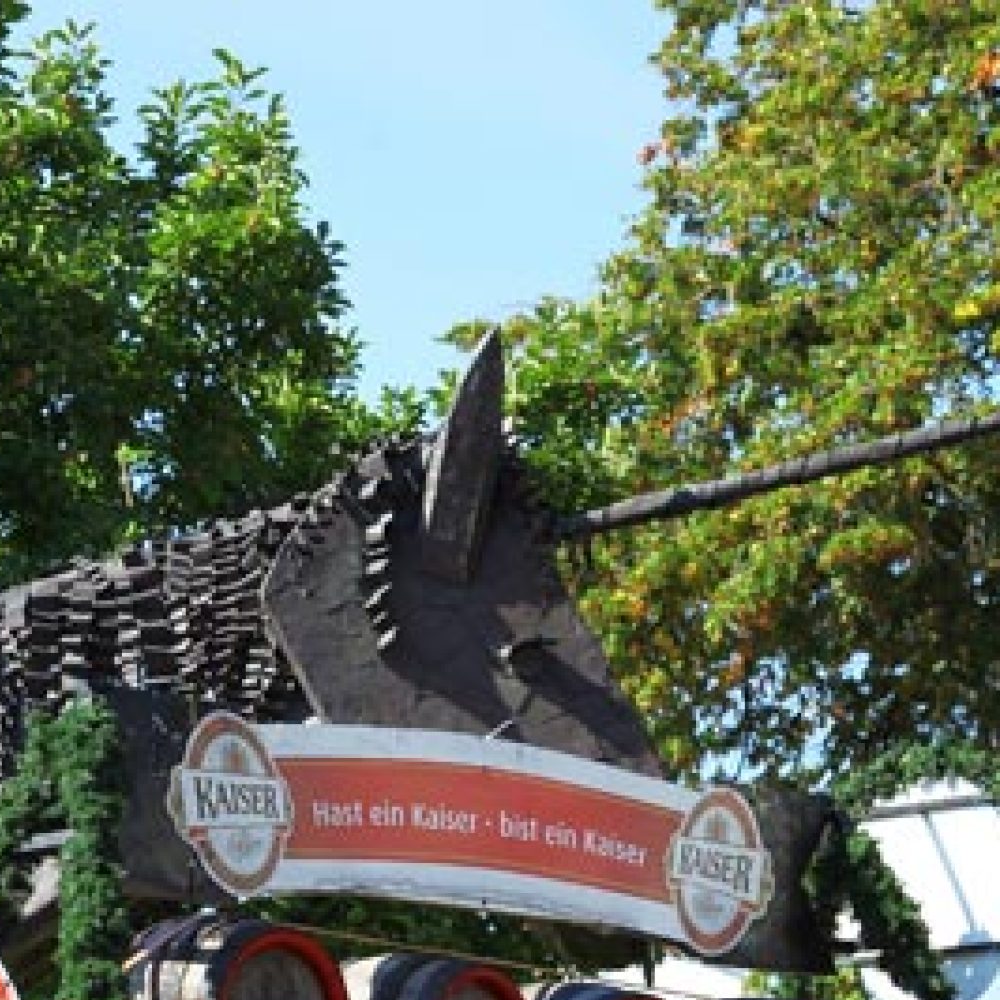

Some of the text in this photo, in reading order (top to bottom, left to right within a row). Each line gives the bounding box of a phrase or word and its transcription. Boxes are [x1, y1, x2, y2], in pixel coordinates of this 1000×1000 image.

[193, 776, 280, 819] KAISER
[312, 800, 647, 867] Hast ein Kaiser bist ein Kaiser
[680, 842, 753, 894] KAISER
